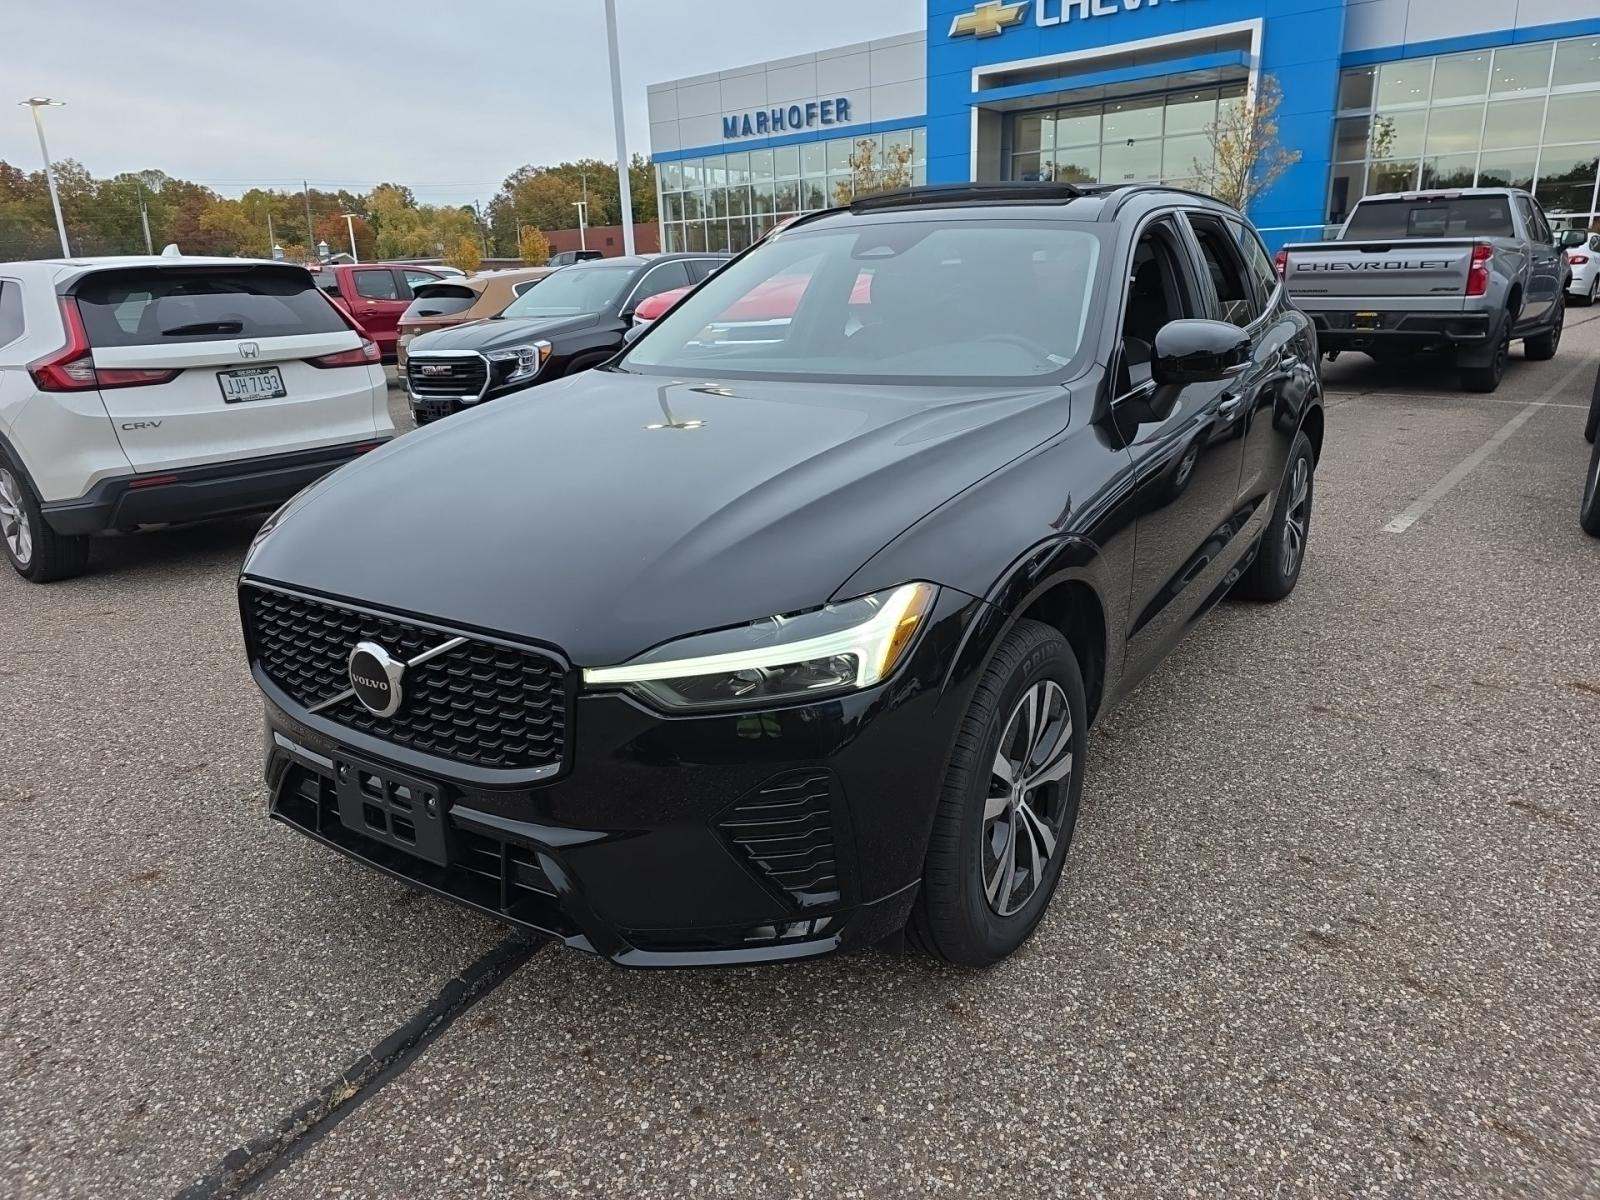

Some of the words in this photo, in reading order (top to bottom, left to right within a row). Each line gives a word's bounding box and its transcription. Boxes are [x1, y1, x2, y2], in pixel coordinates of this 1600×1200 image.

[722, 97, 851, 139] MARHOFER
[1297, 260, 1457, 272] CHEVROLET
[422, 365, 452, 377] GMC
[228, 378, 249, 395] JJH
[249, 375, 280, 393] 7193
[121, 420, 162, 431] CR-V
[352, 673, 388, 691] VOLVO
